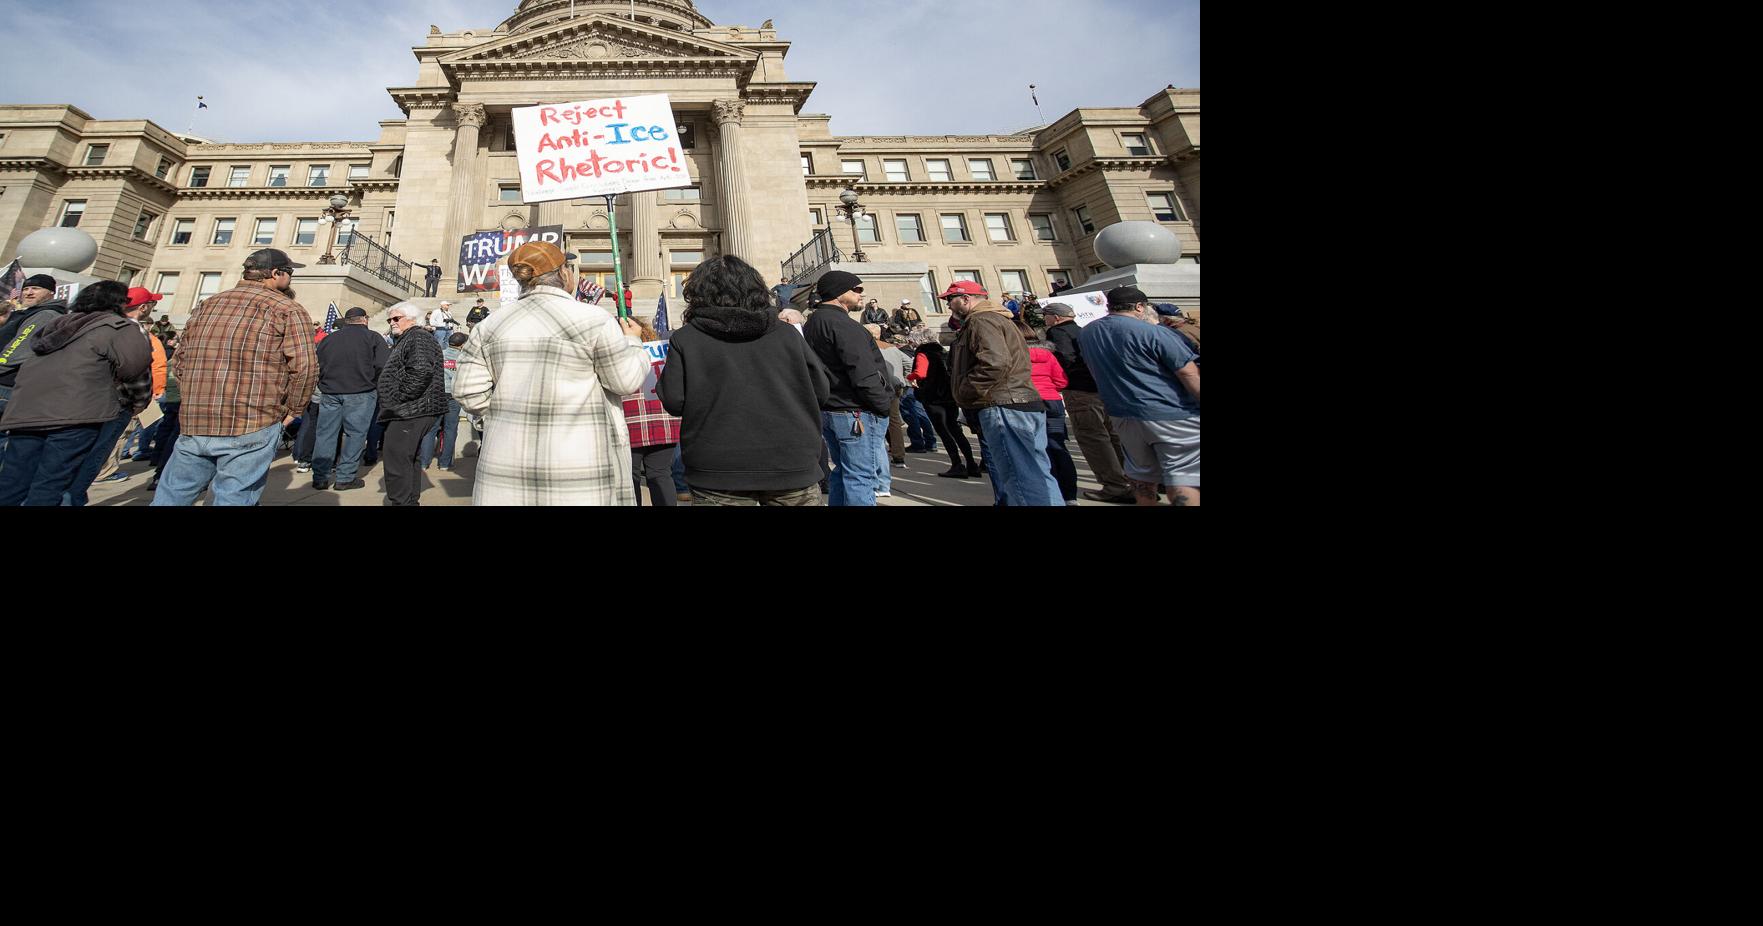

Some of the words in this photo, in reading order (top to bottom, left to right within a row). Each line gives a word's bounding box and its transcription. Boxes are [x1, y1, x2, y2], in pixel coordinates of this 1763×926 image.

[540, 99, 627, 126] Reject
[537, 123, 669, 153] Anti-Ice
[535, 147, 681, 186] Rhetoric!
